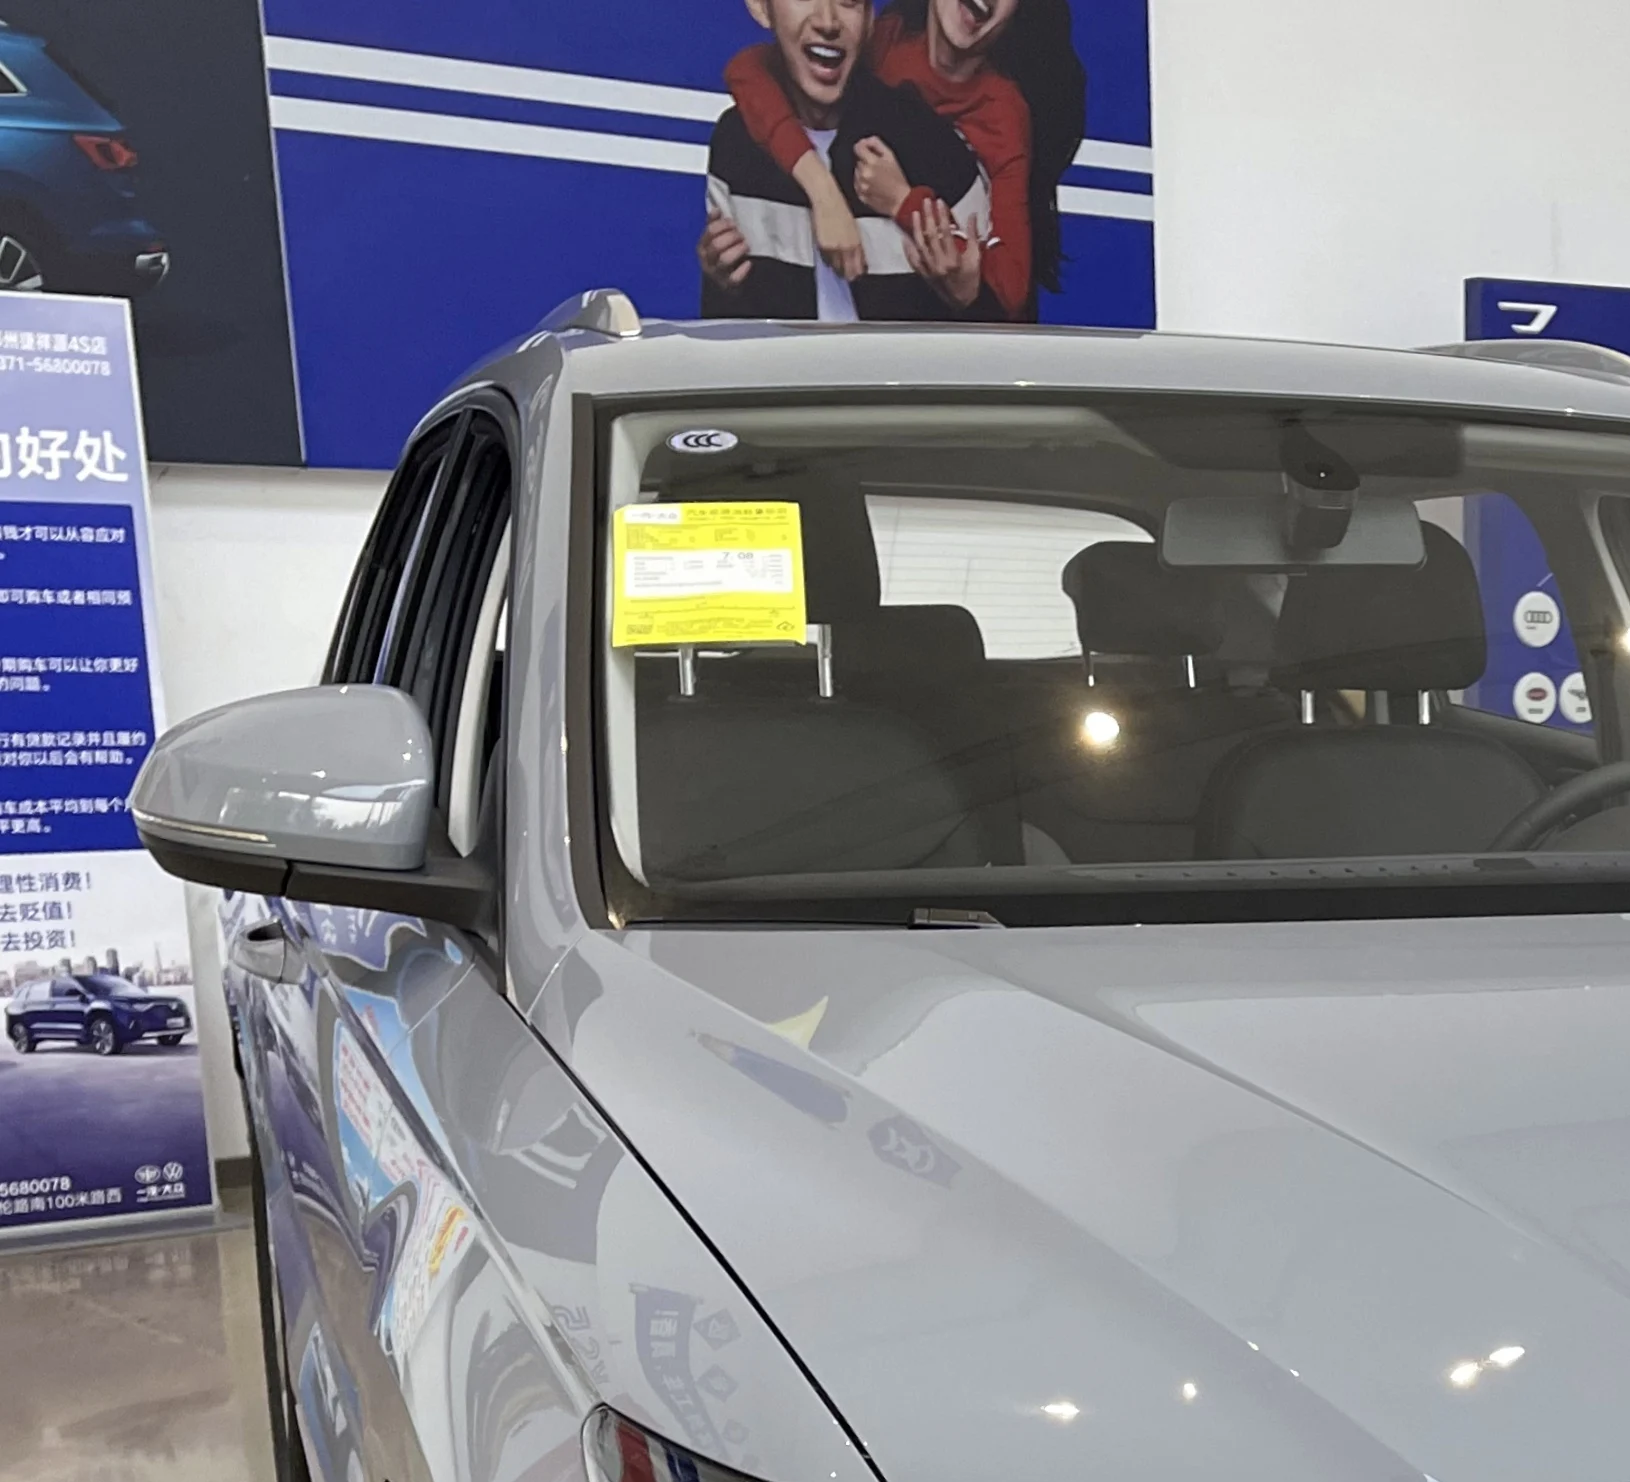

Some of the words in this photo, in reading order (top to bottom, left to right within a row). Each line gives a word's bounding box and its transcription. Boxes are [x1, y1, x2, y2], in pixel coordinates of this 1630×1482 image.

[0, 525, 126, 543] 钱才可以从容应对
